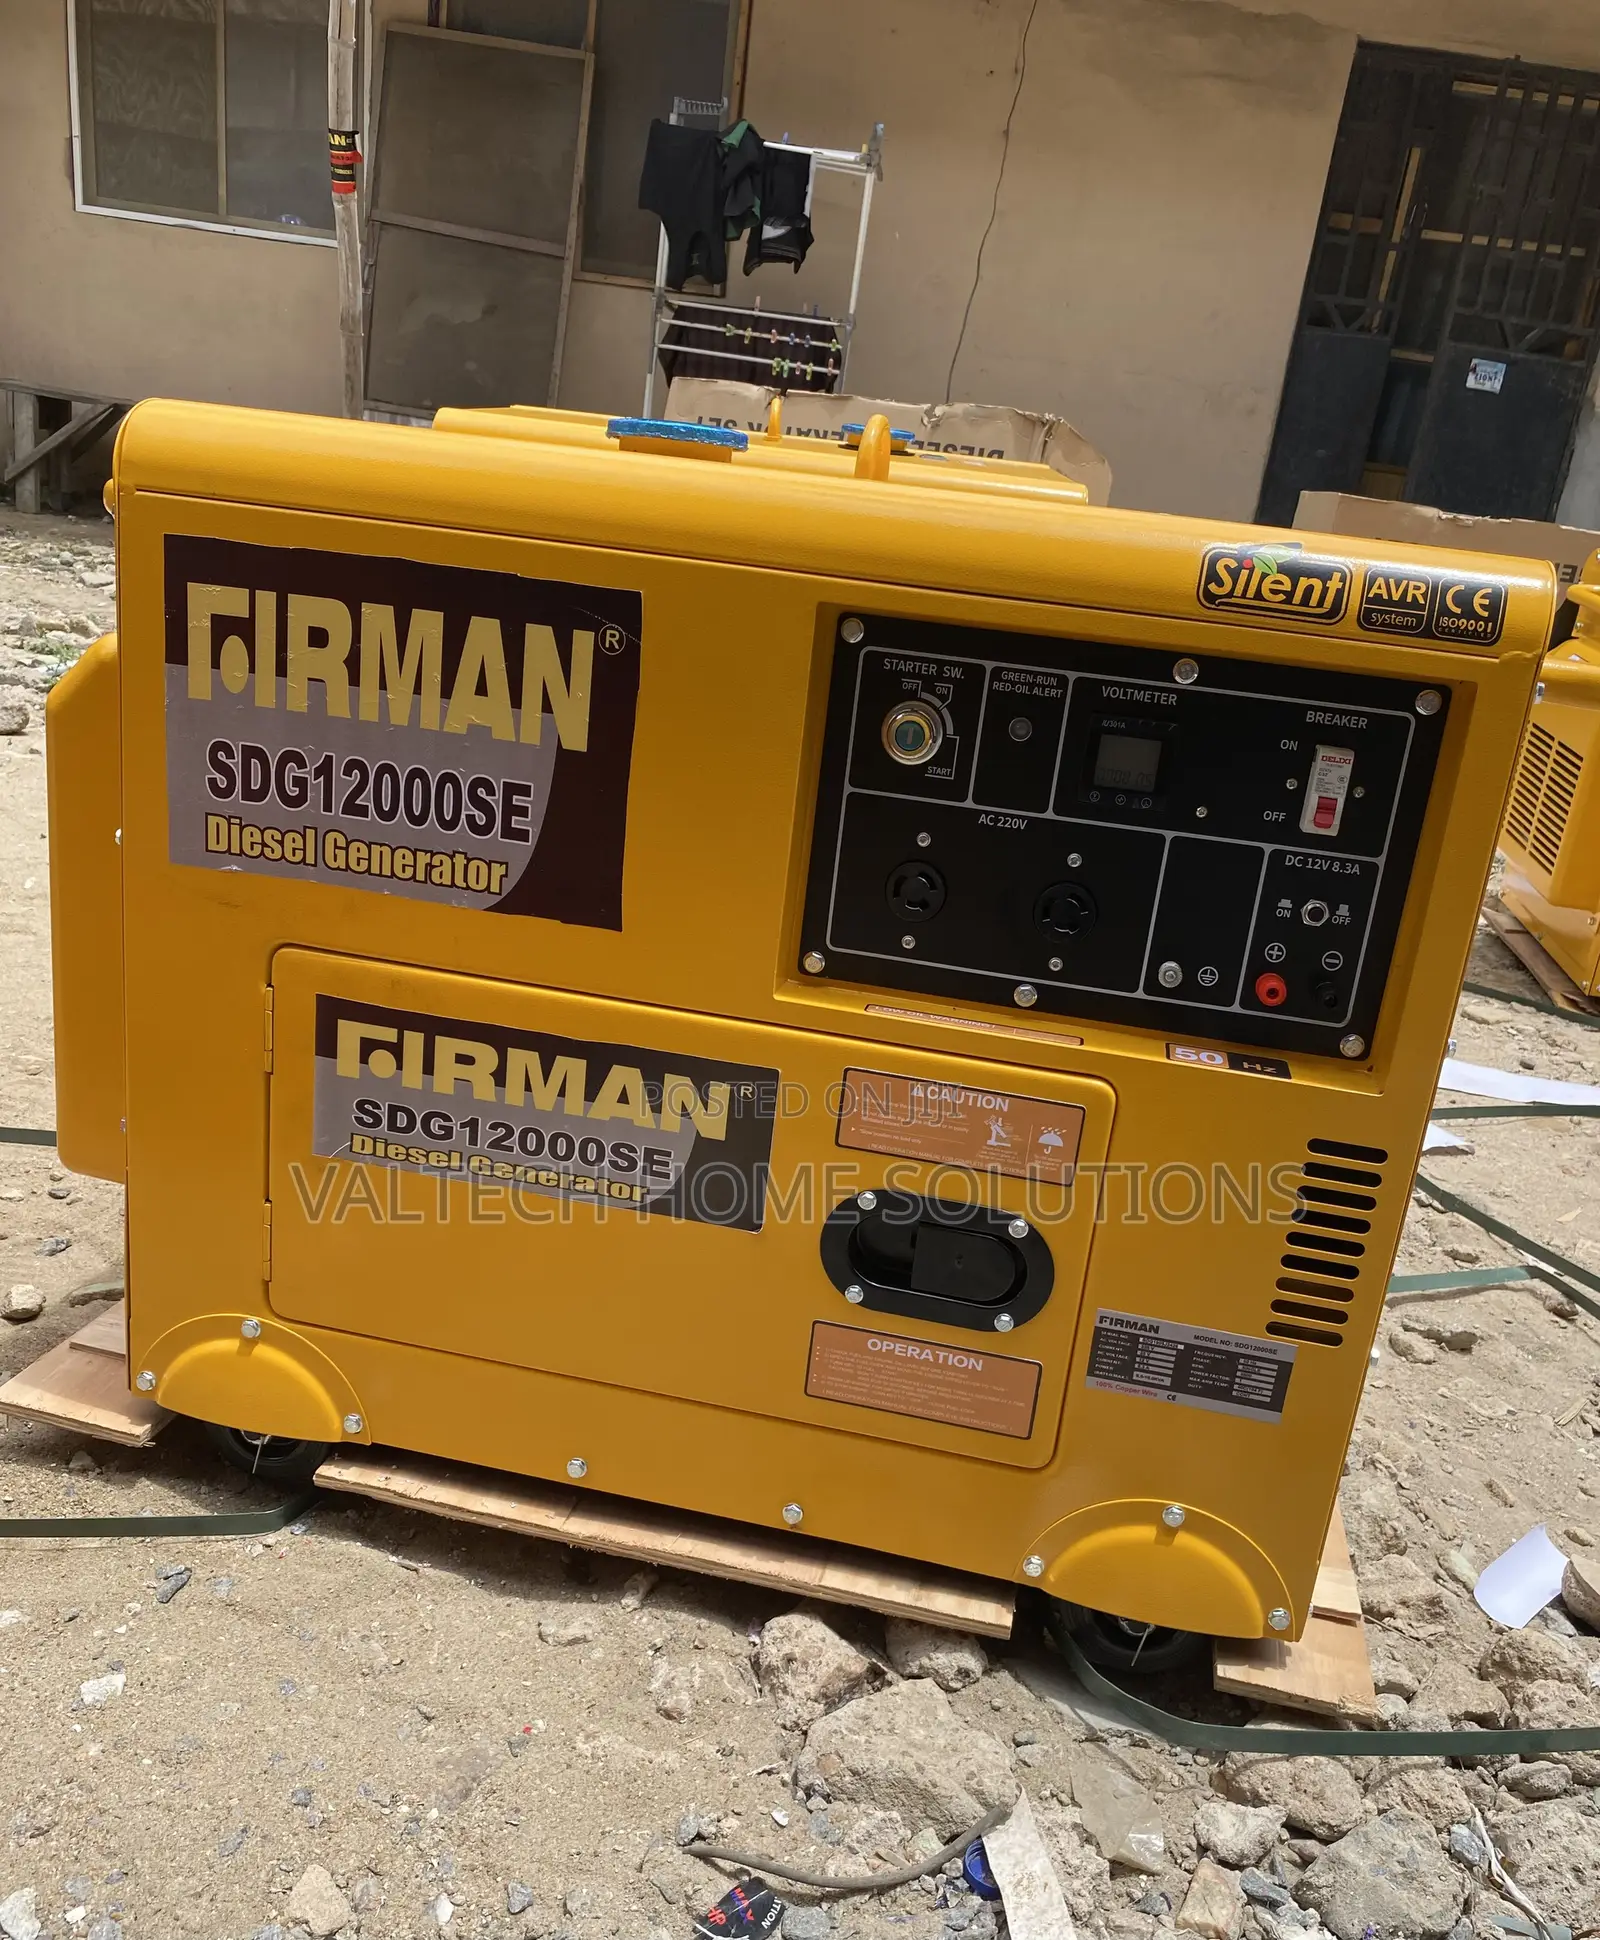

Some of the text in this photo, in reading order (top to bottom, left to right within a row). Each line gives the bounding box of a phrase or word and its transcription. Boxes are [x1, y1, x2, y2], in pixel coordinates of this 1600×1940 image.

[1207, 555, 1344, 611] Silent
[1367, 576, 1427, 605] AVR
[1371, 611, 1417, 628] system
[1438, 616, 1493, 633] ISO9001
[187, 582, 595, 752] FIRMAN
[883, 658, 965, 679] STARTER SW.
[901, 681, 948, 696] OFF ON
[1001, 671, 1058, 687] GREEN-RUN
[992, 681, 1064, 699] RED-OIL ALERT
[1101, 685, 1178, 706] VOLTMETER
[1305, 710, 1369, 730] BREAKER
[1280, 739, 1299, 751] ON
[1320, 755, 1353, 765] DELIXI
[927, 765, 952, 776] START
[205, 738, 534, 846] SDG12000SE
[978, 813, 1028, 831] AC 220V
[1262, 810, 1287, 823] OFF
[204, 812, 508, 896] Diesel Generator
[1284, 854, 1361, 876] DC 12V 8.3A
[1275, 908, 1292, 919] ON
[1331, 914, 1352, 926] OFF
[874, 1005, 905, 1015] LOW
[1173, 1046, 1278, 1074] 50 Hz
[336, 1019, 731, 1141] FIRMAN
[926, 1085, 1010, 1112] CAUTION
[352, 1097, 675, 1182] SDG12000SE
[350, 1132, 651, 1204] Diesel Generator
[1098, 1315, 1160, 1335] FIRMAN
[1193, 1334, 1278, 1355] MODEL NO: SDG12000SE
[867, 1338, 984, 1372] OPERATION
[1095, 1380, 1158, 1397] 100% Copper Wire
